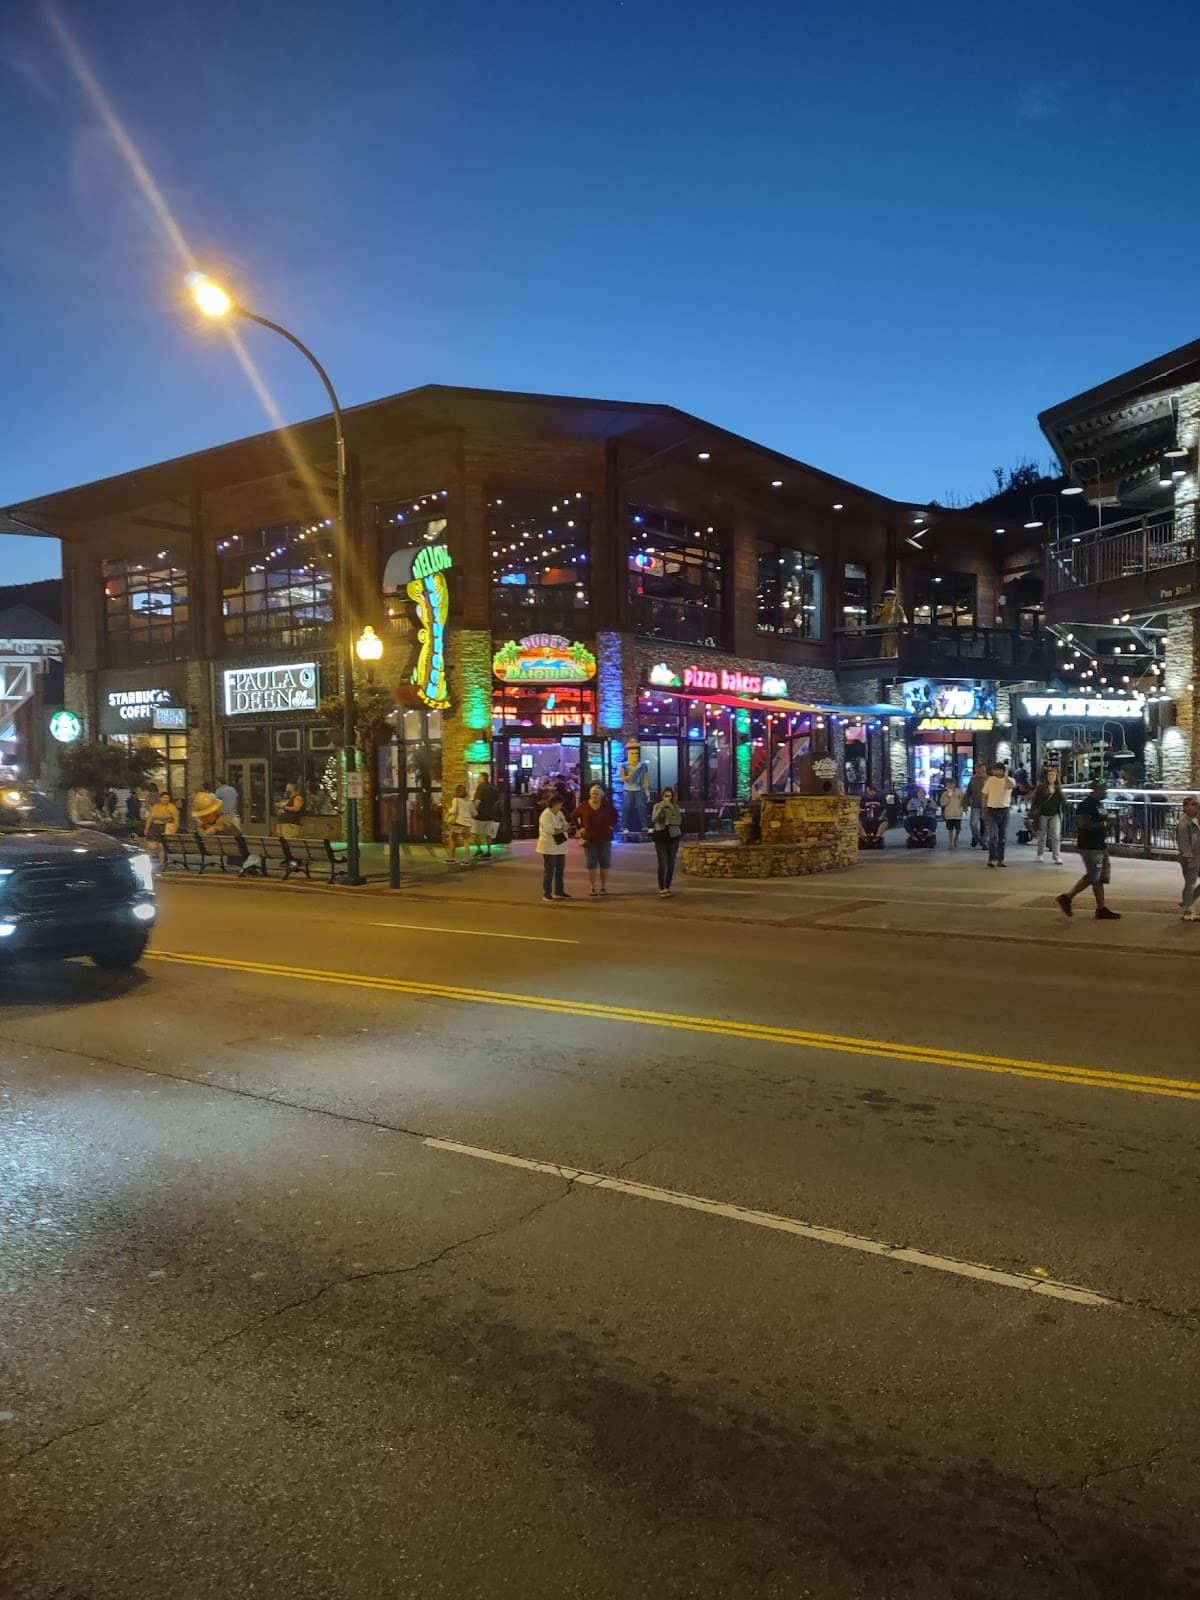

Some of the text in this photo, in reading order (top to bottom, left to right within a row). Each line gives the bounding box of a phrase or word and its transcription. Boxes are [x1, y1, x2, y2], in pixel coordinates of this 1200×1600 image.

[233, 668, 297, 692] PAULA
[233, 688, 294, 712] DEEN
[120, 703, 161, 719] COFF
[917, 717, 995, 731] ADVENTURE
